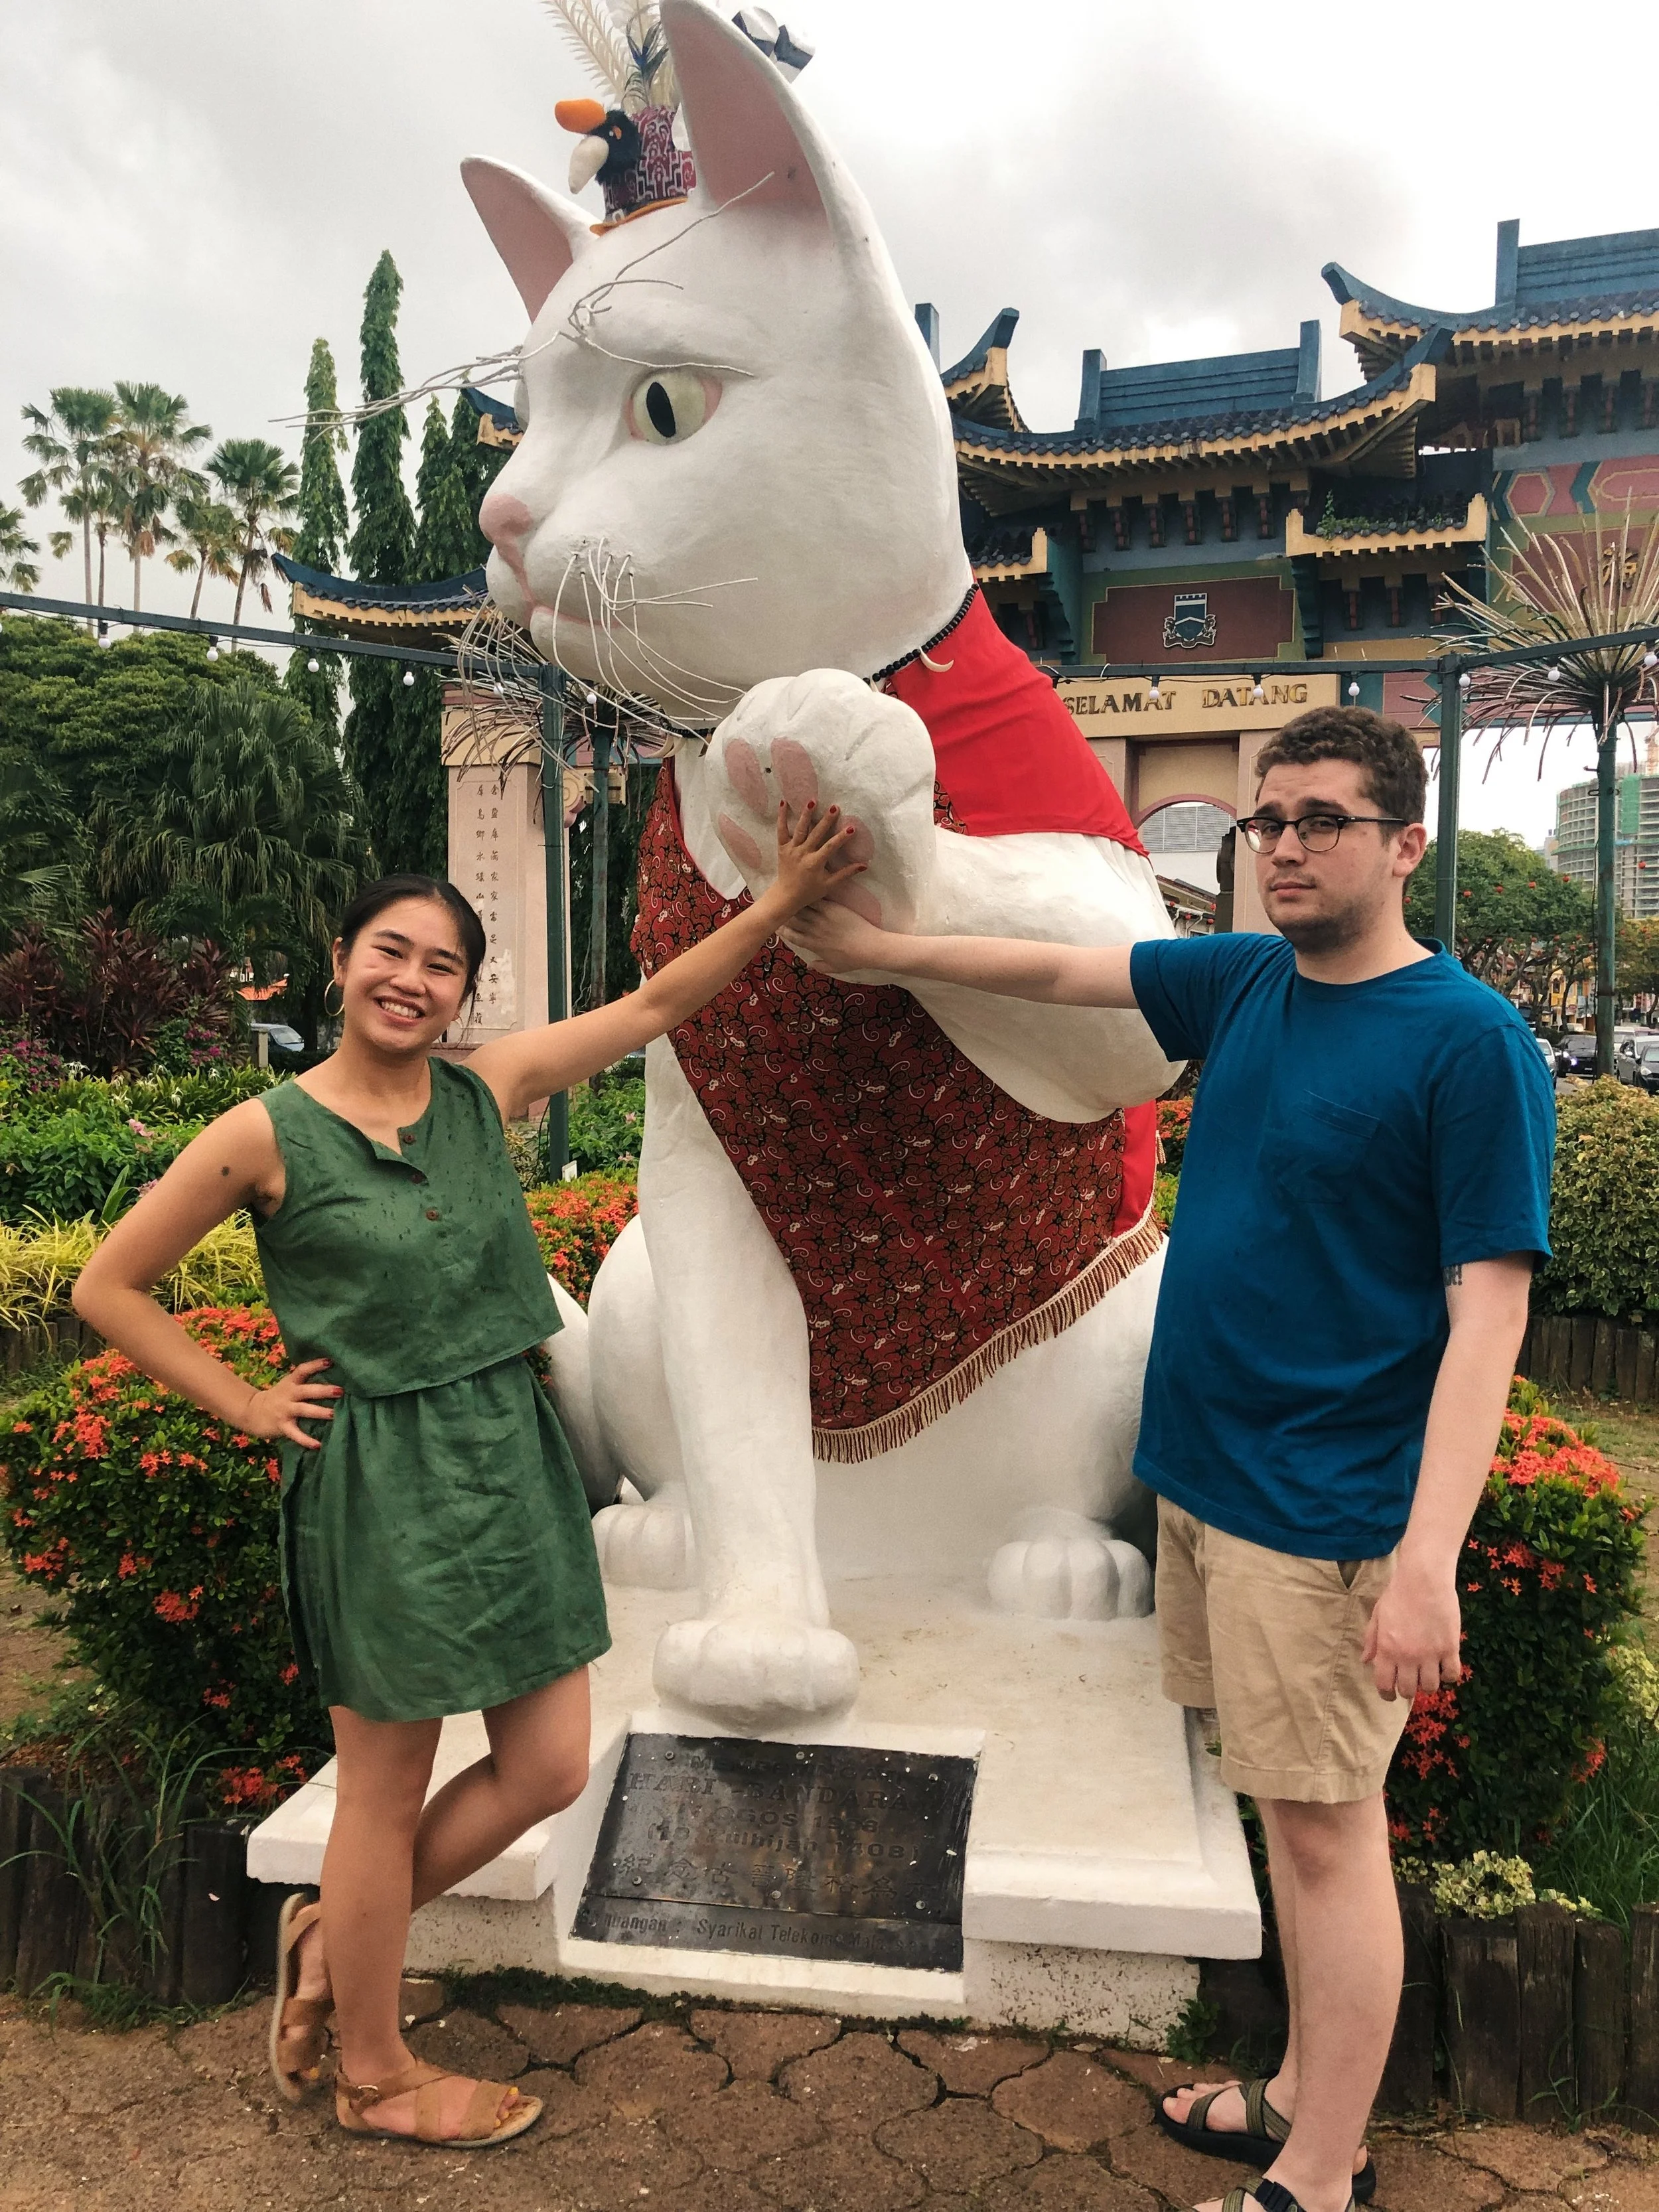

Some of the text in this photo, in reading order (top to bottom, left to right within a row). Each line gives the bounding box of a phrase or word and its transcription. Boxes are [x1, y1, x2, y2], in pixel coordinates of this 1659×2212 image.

[1063, 684, 1307, 715] SELAMAT DATANG
[627, 1773, 717, 1796] HARI
[713, 1806, 799, 1827] OGOS
[697, 1917, 763, 1941] Syarikat
